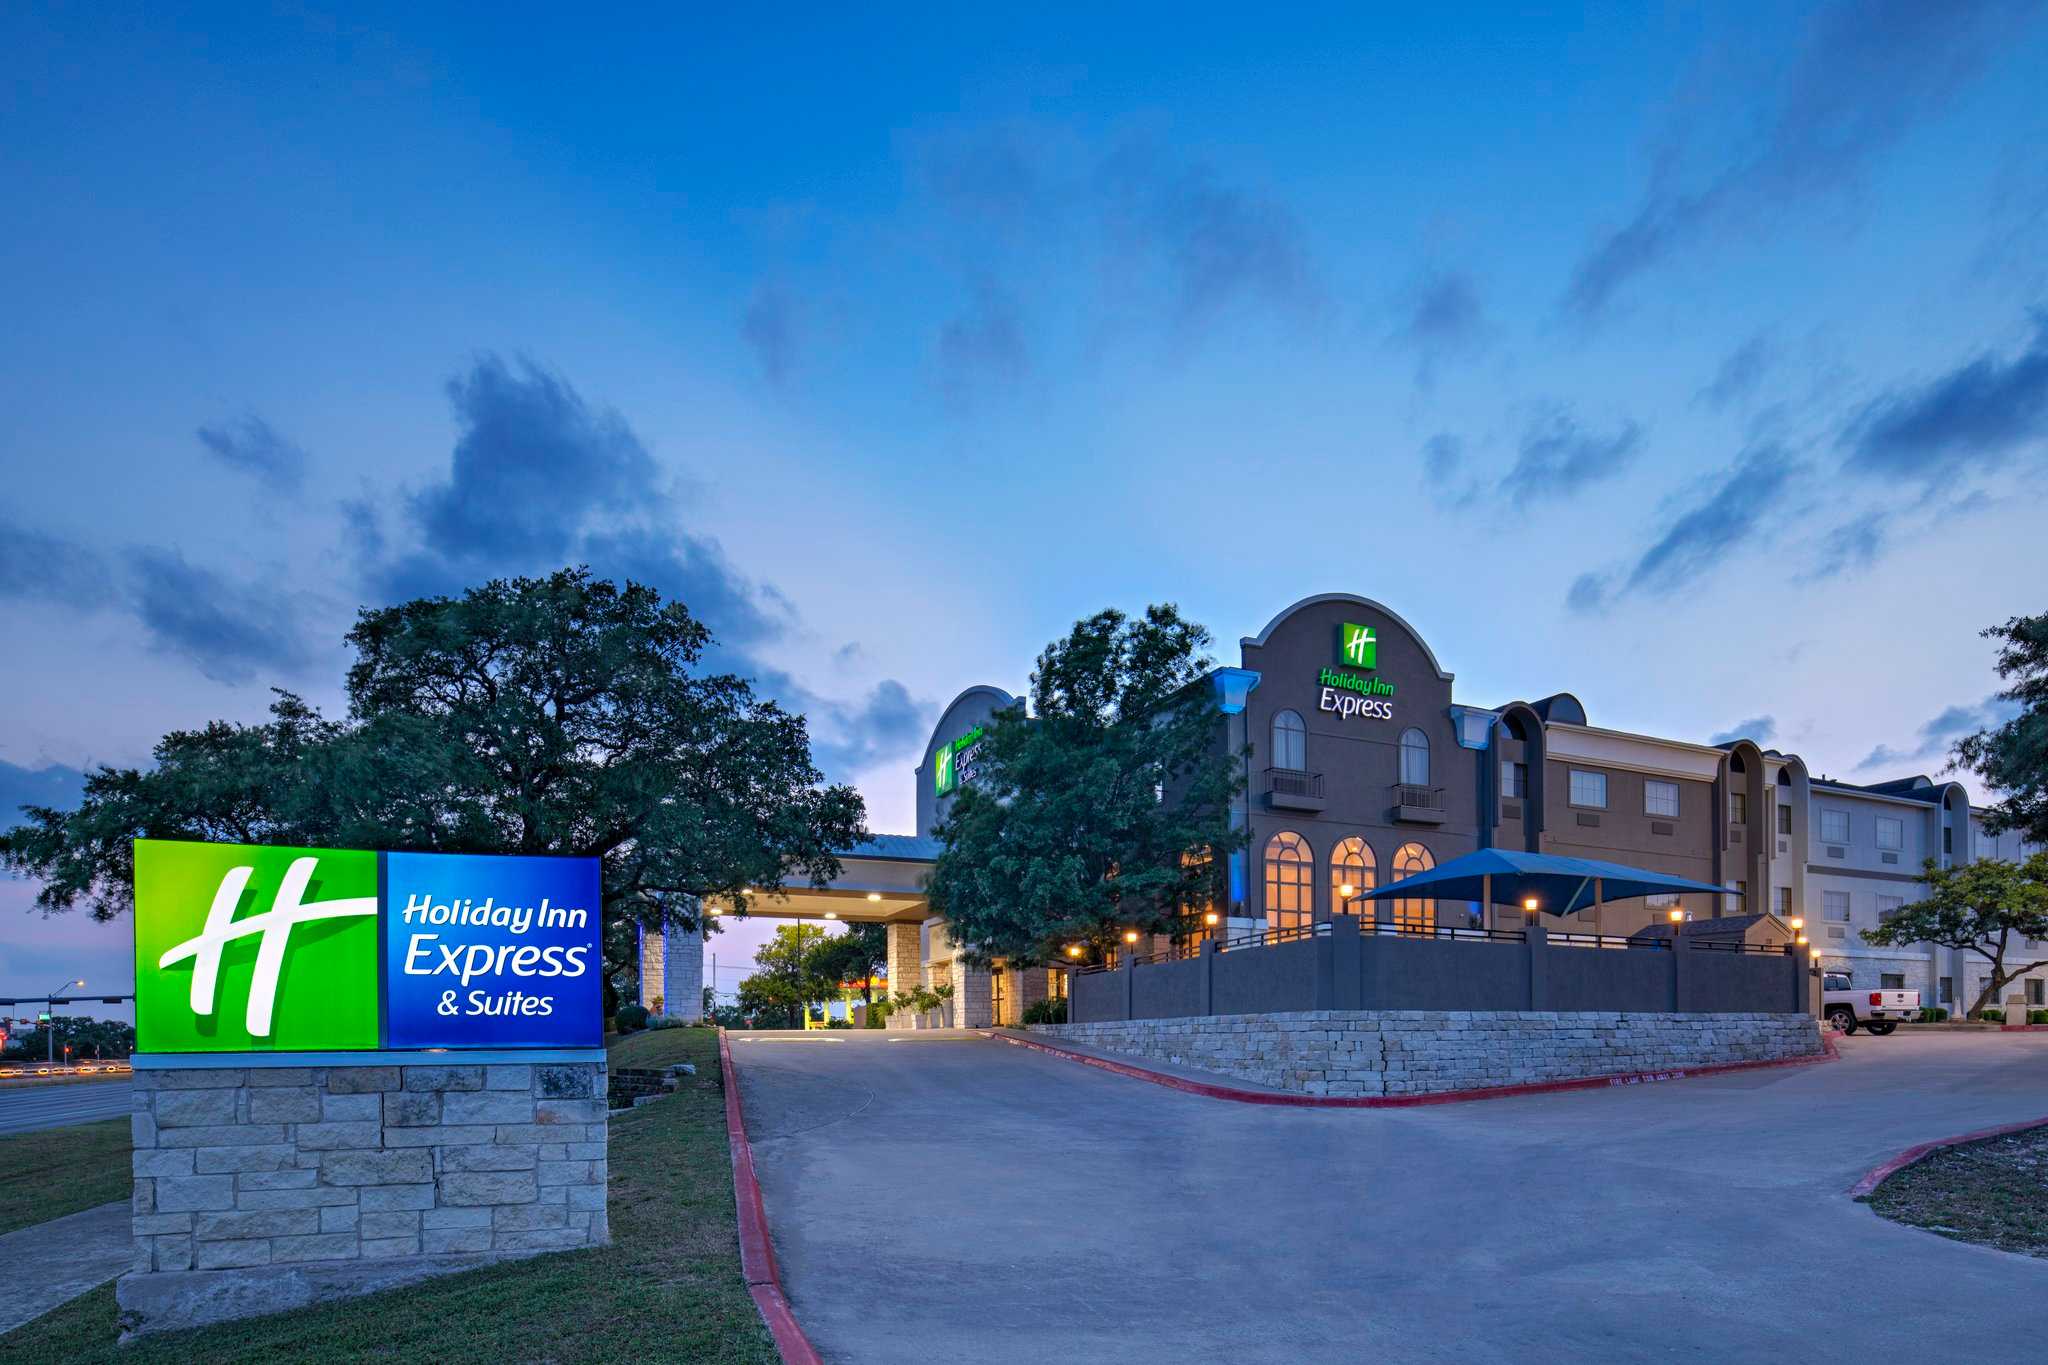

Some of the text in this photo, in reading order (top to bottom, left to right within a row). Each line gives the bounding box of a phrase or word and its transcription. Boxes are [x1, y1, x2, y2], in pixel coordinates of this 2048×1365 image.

[1320, 667, 1394, 696] Holiday Inn
[1320, 687, 1393, 720] Express
[401, 894, 588, 934] Holiday Inn
[403, 934, 588, 986] Express
[437, 990, 554, 1016] & Suites
